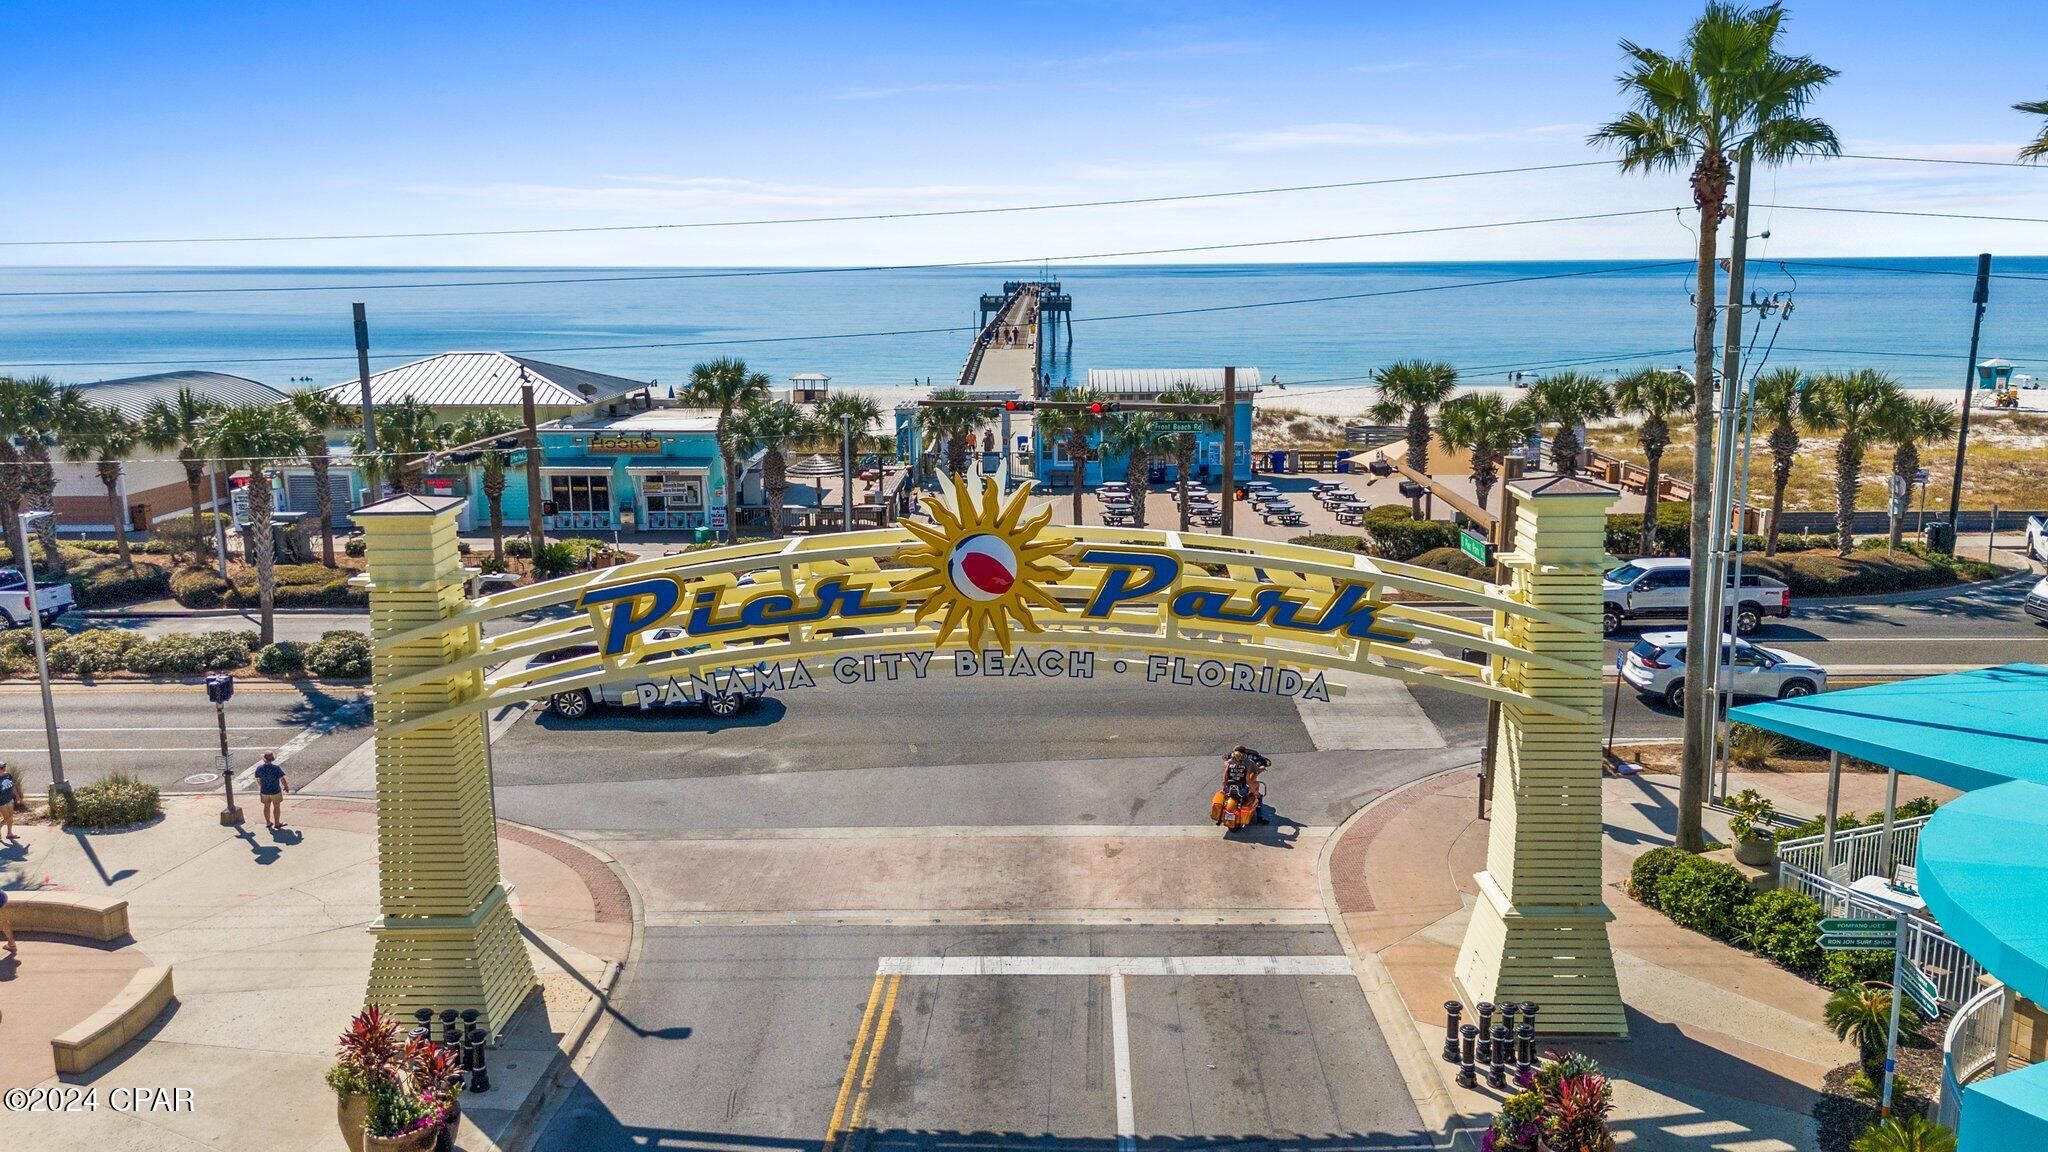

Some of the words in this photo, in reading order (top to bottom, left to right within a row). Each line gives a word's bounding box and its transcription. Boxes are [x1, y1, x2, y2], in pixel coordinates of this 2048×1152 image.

[574, 572, 906, 657] Pier
[1077, 545, 1415, 644] Park
[636, 658, 816, 710] PANAMA
[833, 651, 934, 684] CITY
[955, 647, 1094, 678] BEACH
[1147, 655, 1330, 702] FLORIDA
